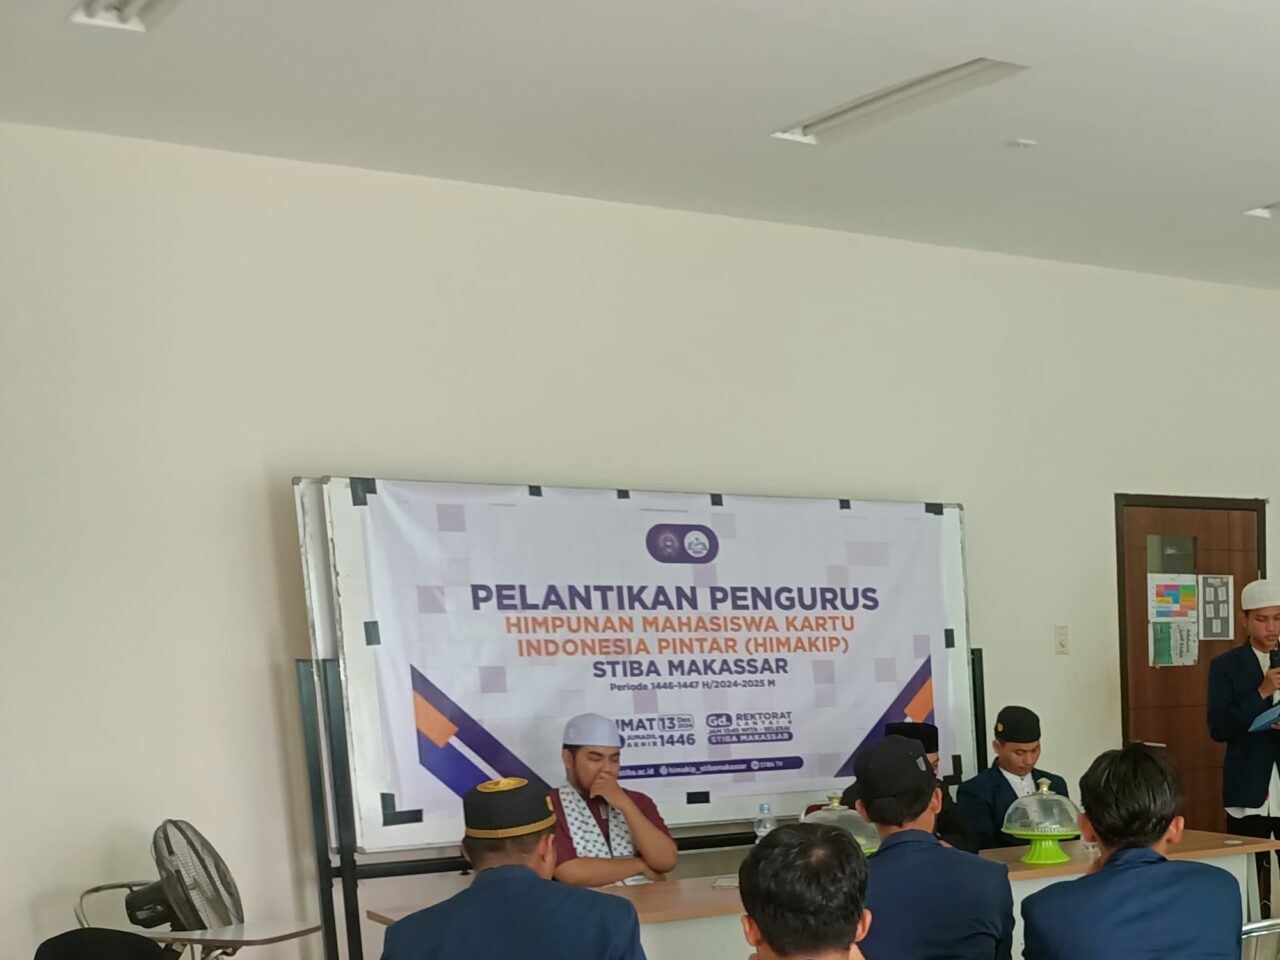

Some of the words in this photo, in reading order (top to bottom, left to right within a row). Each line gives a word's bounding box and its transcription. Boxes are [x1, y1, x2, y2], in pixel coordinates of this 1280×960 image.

[470, 584, 698, 611] PELANTIKAN
[709, 586, 880, 611] PENGURUS
[505, 616, 635, 634] HIMPUNAN
[642, 615, 779, 633] MAHASISWA
[785, 615, 855, 632] KARTU
[517, 637, 651, 657] INDONESIA
[657, 637, 738, 655] PINTAR
[745, 636, 850, 655] (HIMAKIP)
[592, 660, 661, 678] STIBA
[668, 658, 789, 676] MAKASSAR
[609, 682, 648, 692] Periode
[651, 680, 700, 691] 1446-1447
[702, 679, 765, 690] H/2024-2025
[767, 679, 776, 688] M
[659, 716, 676, 730] 13
[708, 714, 731, 726] Gd.
[736, 712, 792, 721] REKTORAT
[659, 733, 696, 747] 1446
[711, 735, 738, 744] STIBA
[740, 732, 789, 742] MAKASSAR
